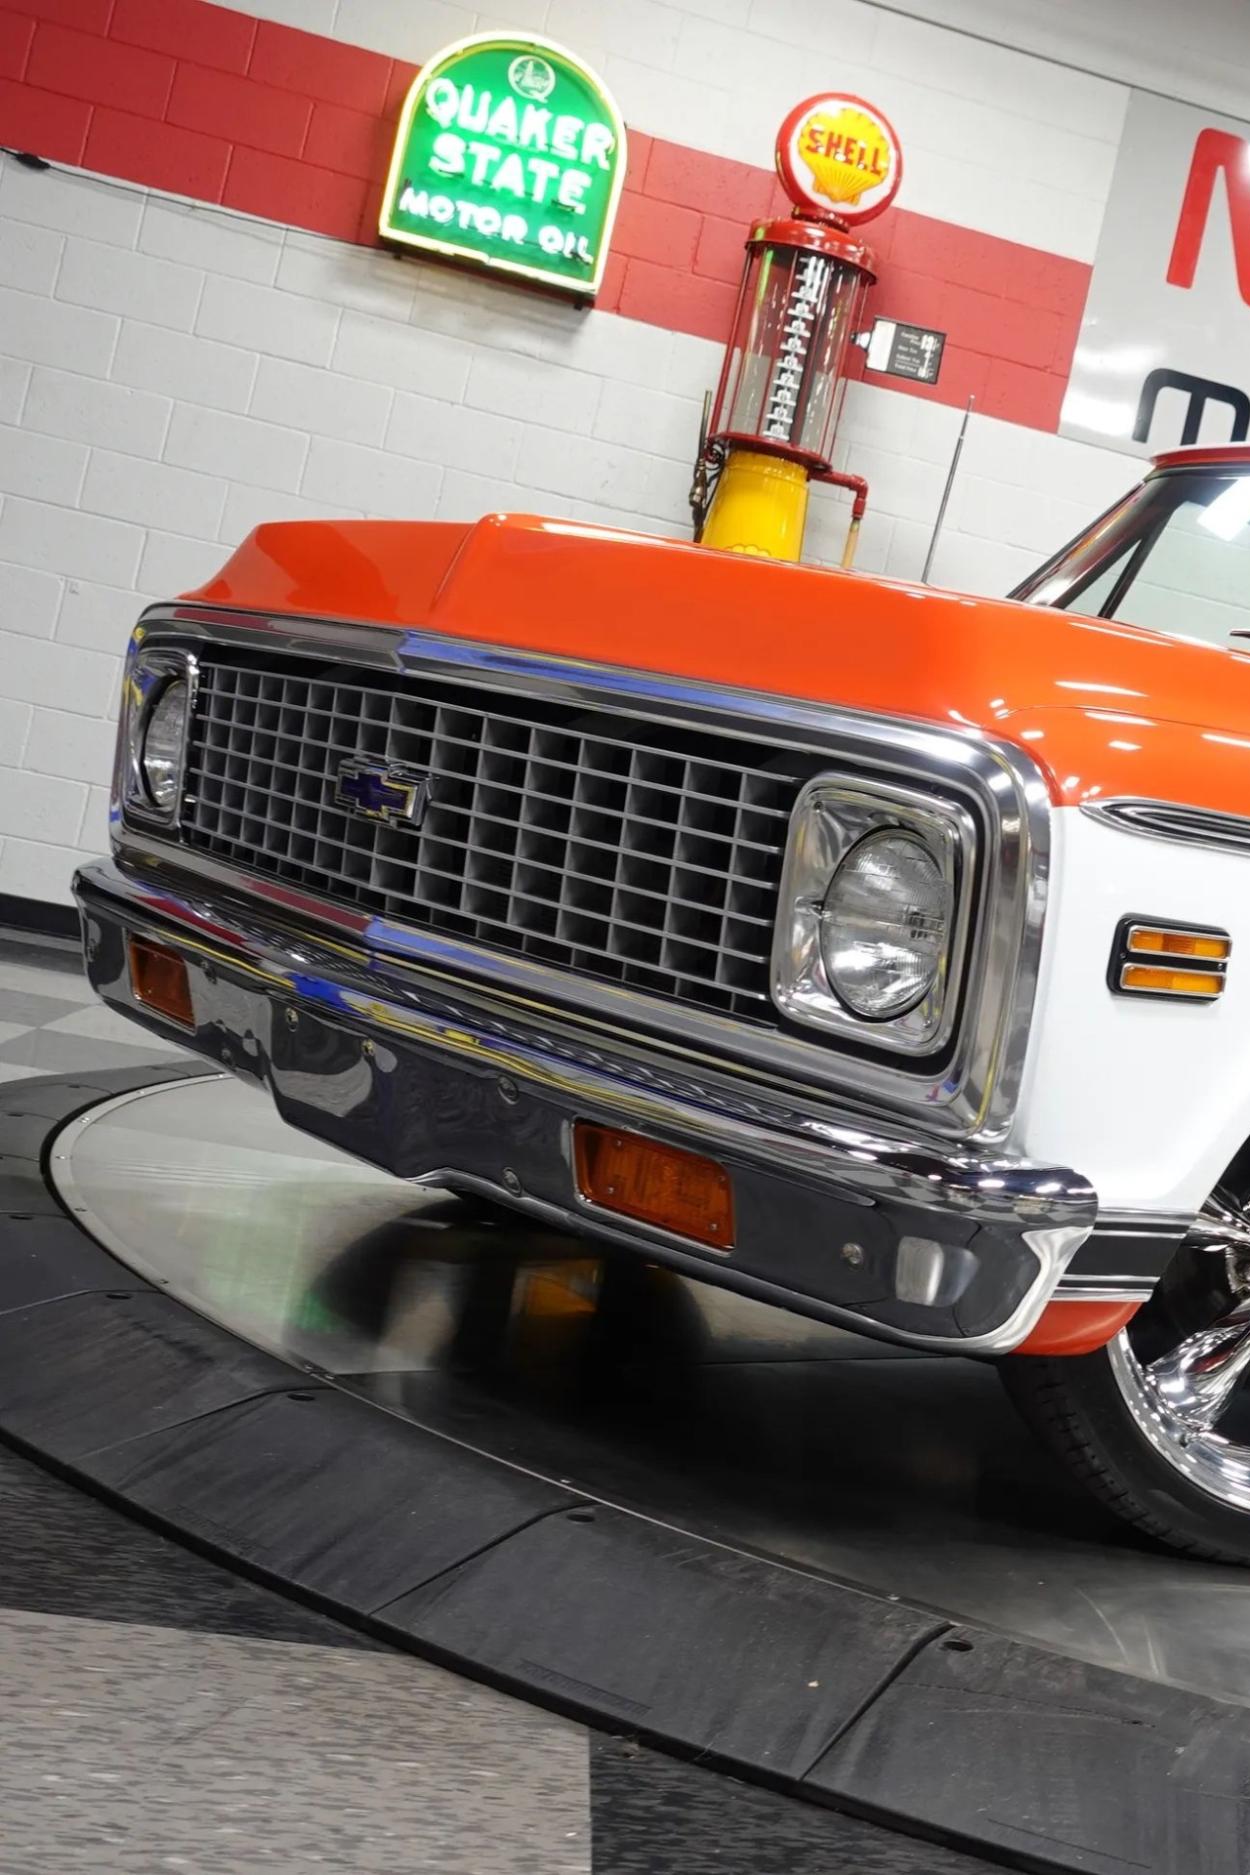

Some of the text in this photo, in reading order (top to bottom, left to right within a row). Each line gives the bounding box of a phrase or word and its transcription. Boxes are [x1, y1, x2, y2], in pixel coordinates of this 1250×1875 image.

[425, 77, 615, 170] QUAKER
[805, 127, 882, 177] SHELL
[429, 133, 592, 215] STATE
[399, 187, 594, 264] MOTOR OIL
